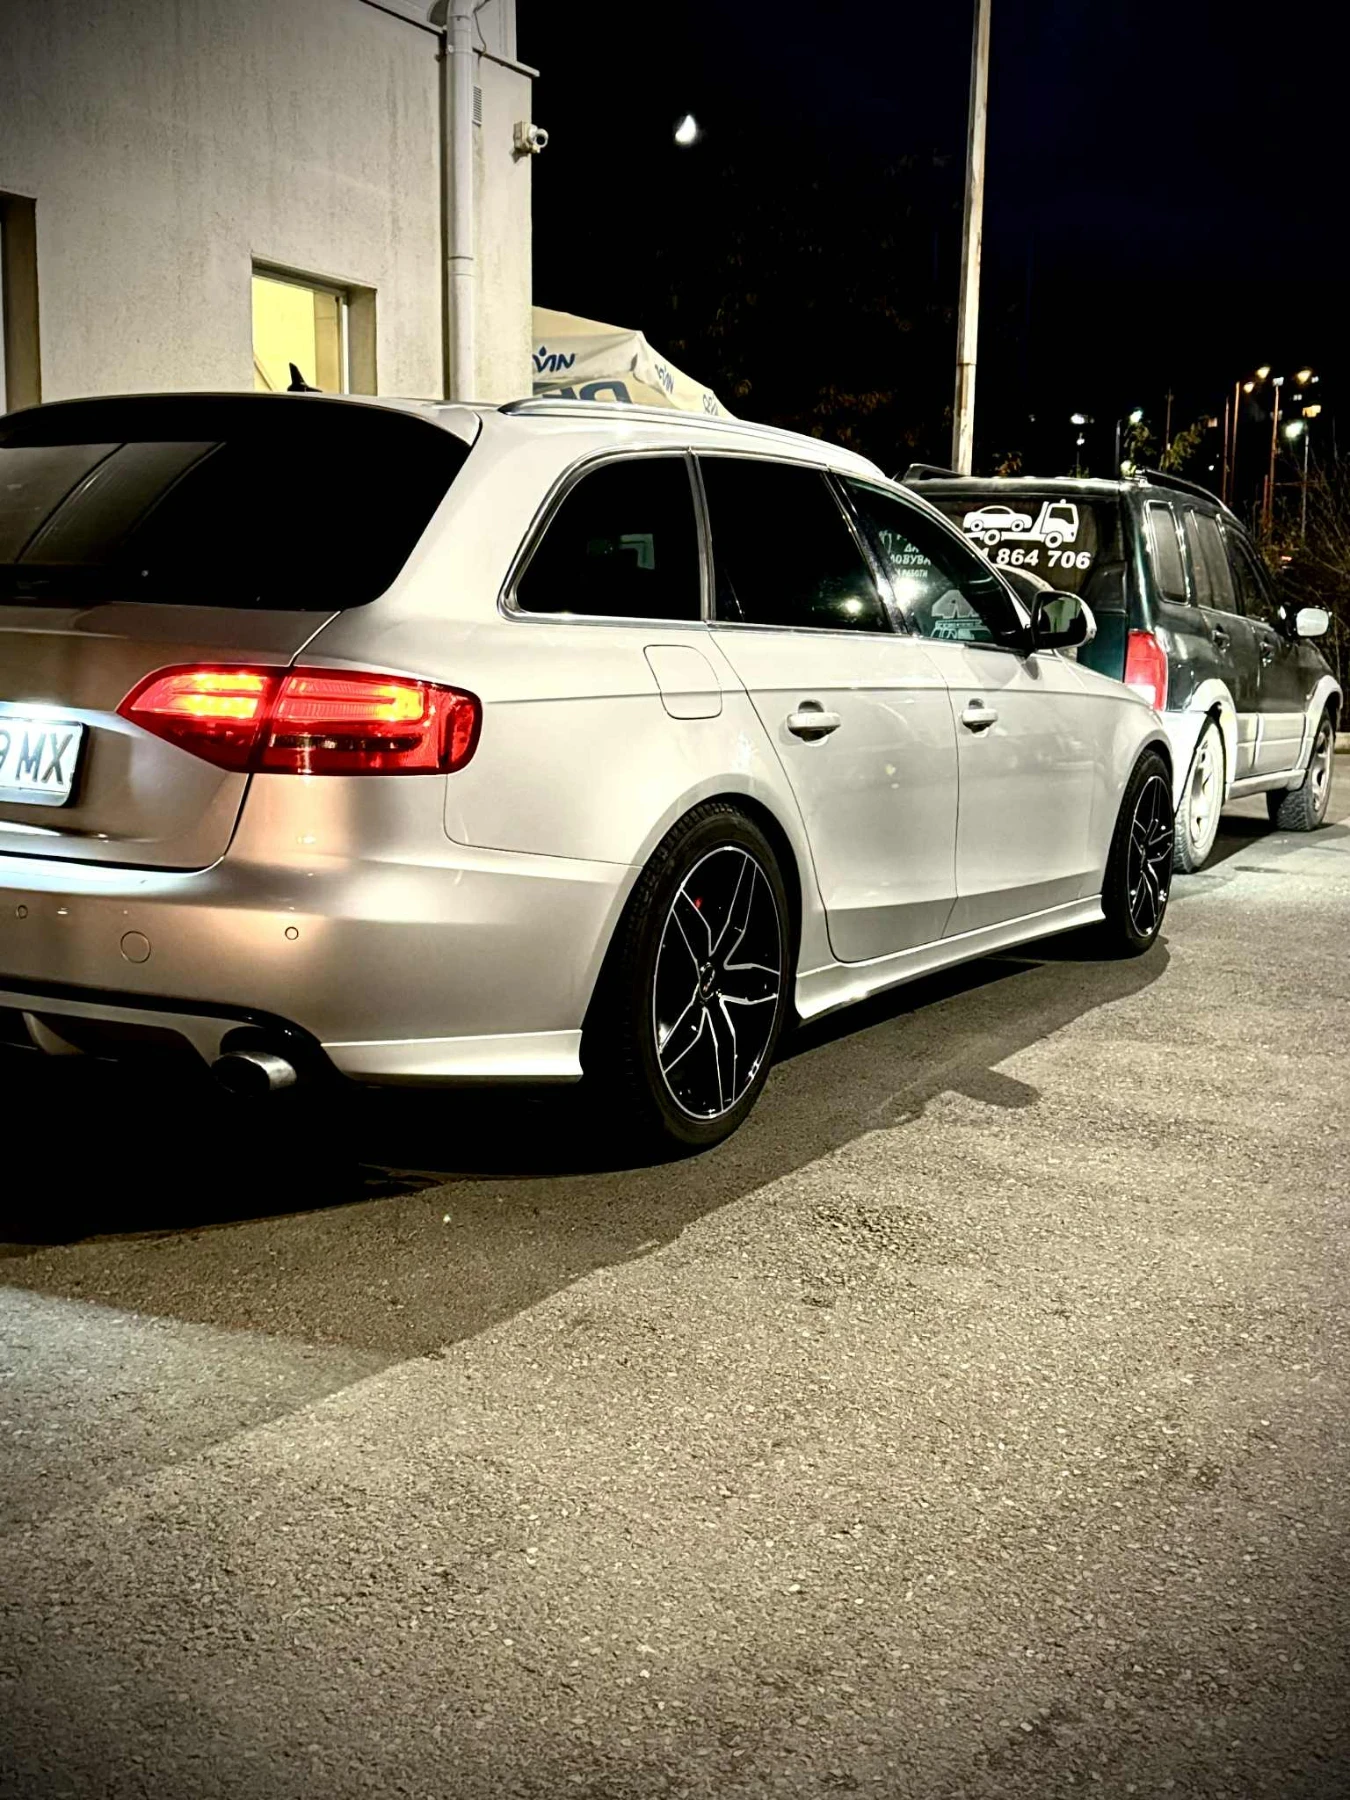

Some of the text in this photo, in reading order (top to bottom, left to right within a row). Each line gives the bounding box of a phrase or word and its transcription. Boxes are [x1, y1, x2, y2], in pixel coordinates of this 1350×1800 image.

[996, 547, 1040, 566] 864
[1047, 550, 1091, 569] 706
[15, 730, 74, 785] MX
